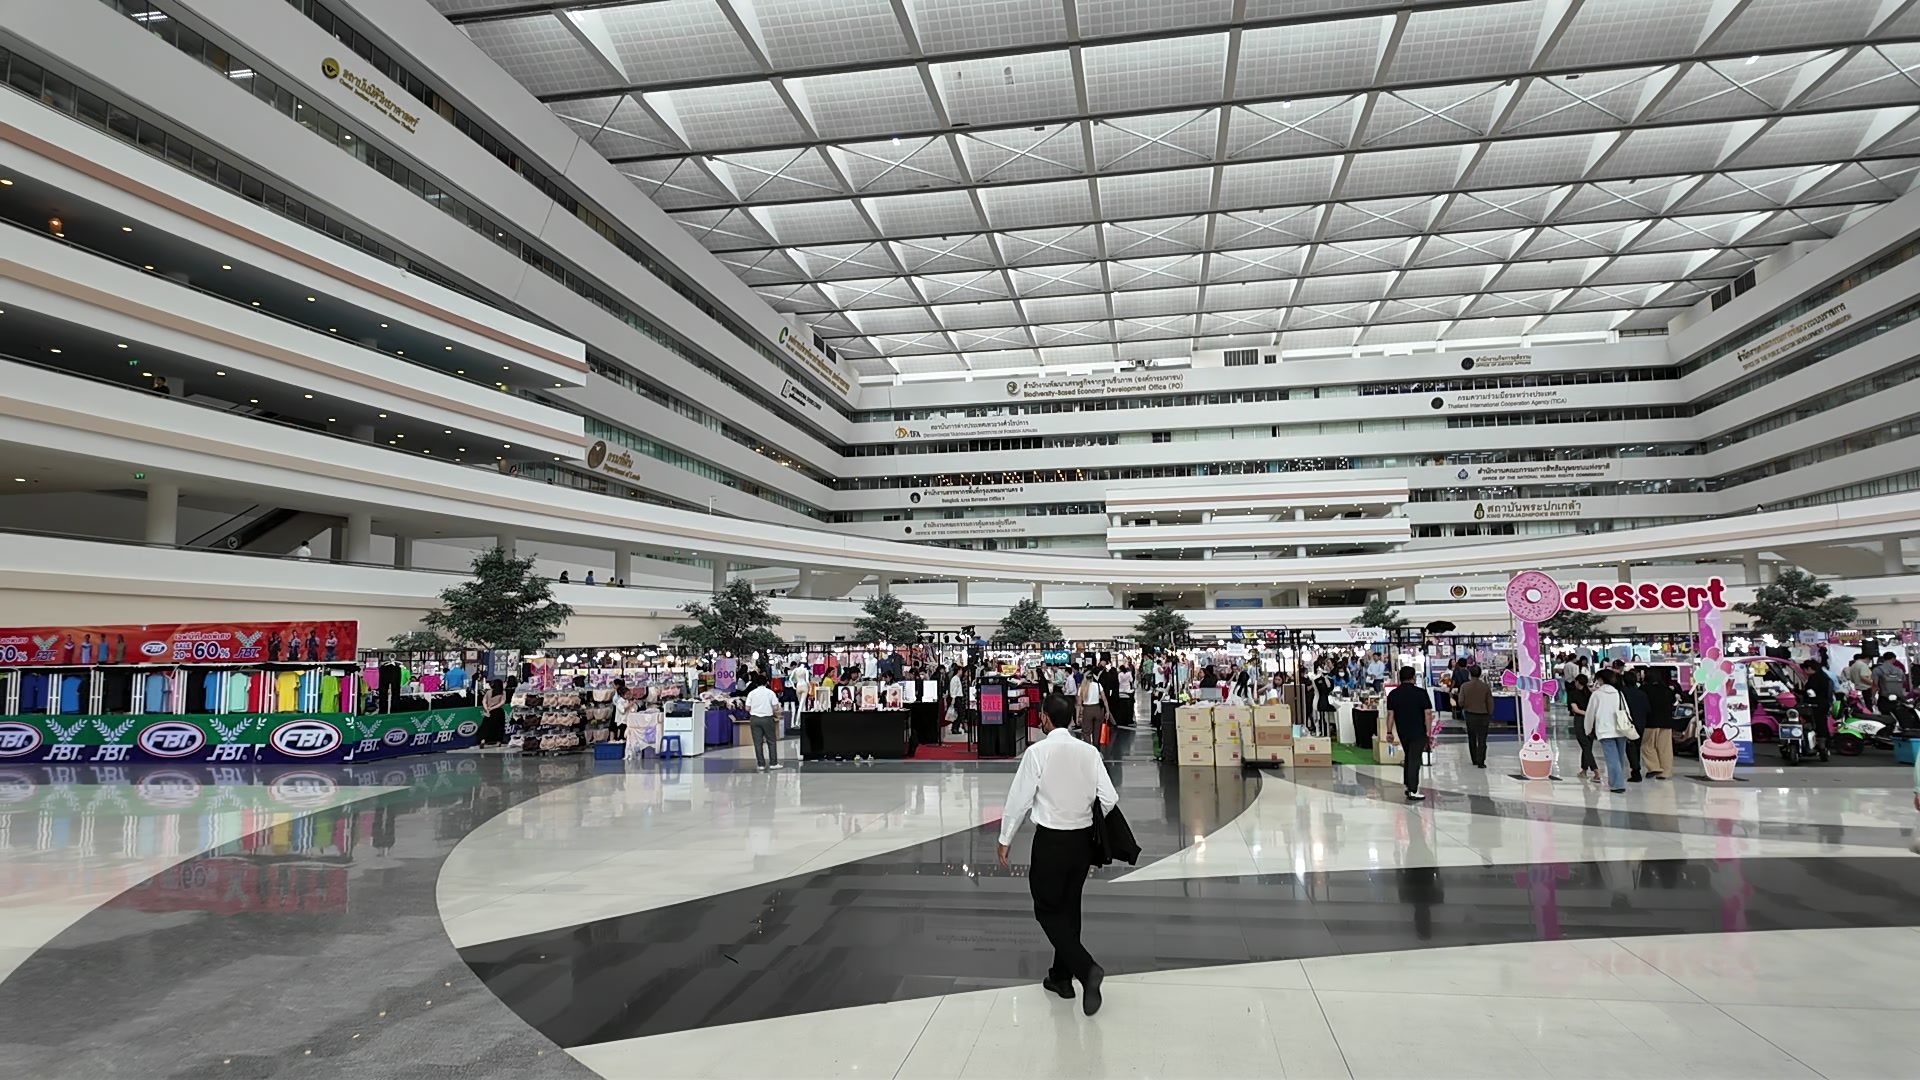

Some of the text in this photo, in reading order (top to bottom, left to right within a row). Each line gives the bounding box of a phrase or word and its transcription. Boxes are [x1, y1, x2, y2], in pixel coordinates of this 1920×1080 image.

[1023, 382, 1183, 398] Biodiversity-Based Economy Development Office (PO)
[1487, 500, 1582, 513] สถาบันพระปกเกล้า
[1564, 578, 1728, 611] dessert
[174, 642, 192, 650] SALE
[717, 670, 735, 679] 990
[983, 701, 1001, 711] SALE
